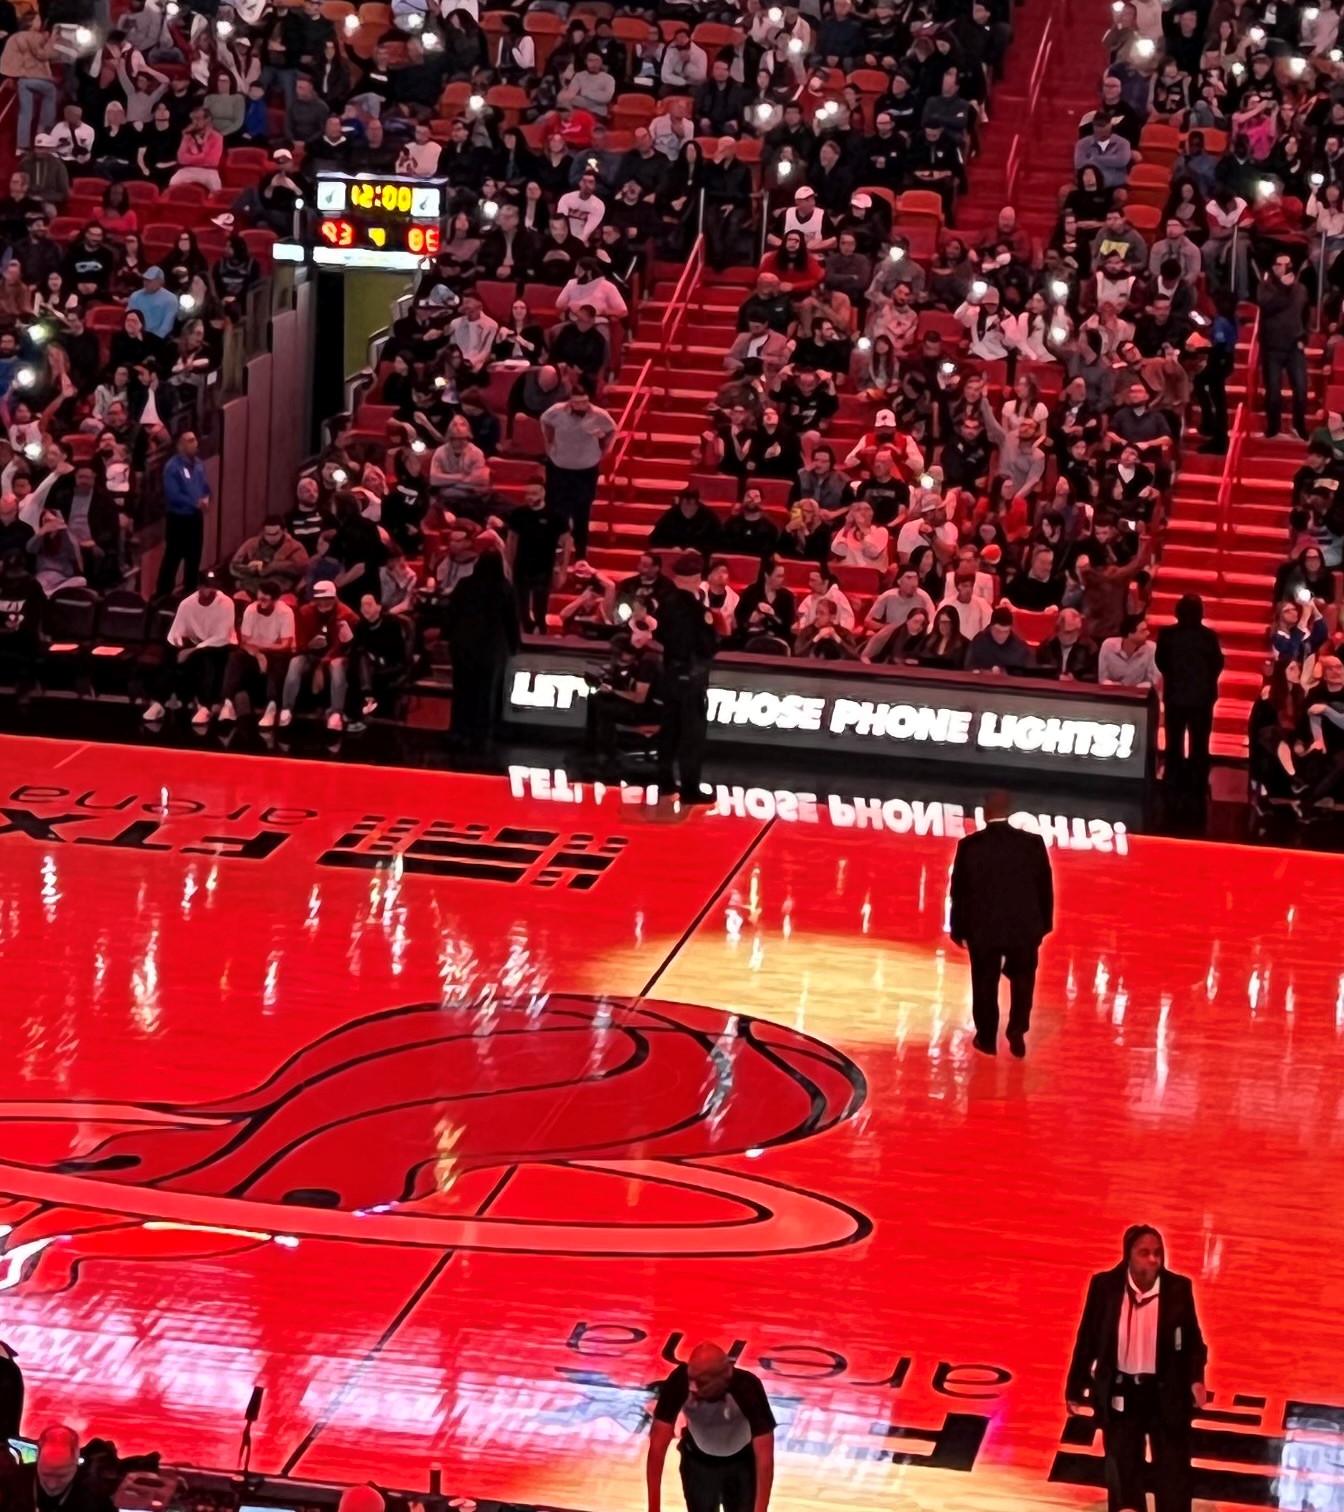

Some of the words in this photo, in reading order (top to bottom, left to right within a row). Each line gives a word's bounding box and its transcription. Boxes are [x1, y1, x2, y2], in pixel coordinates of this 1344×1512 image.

[511, 671, 592, 709] LET'
[706, 688, 826, 730] THOSE
[829, 698, 973, 744] PHONE
[977, 711, 1135, 759] LIGHTS!
